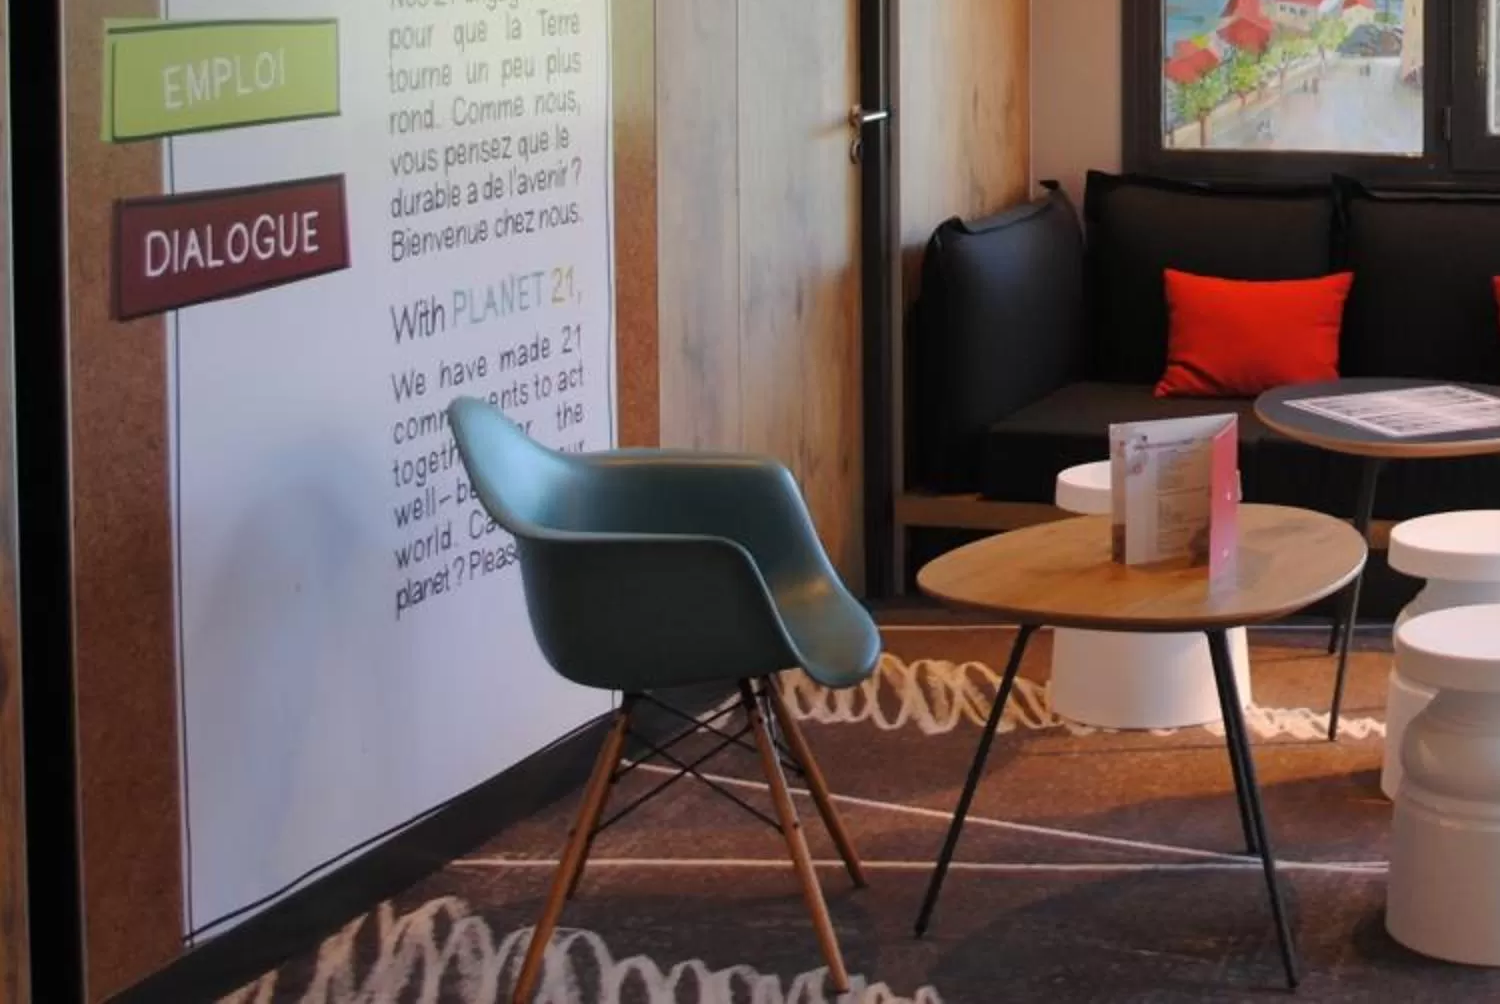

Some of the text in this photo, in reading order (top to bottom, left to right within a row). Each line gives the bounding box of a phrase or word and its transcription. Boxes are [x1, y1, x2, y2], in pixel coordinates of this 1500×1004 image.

[388, 8, 580, 58] pour que la Terre
[161, 48, 285, 111] EMPLOI
[388, 47, 582, 94] tourne un peu plus
[452, 96, 525, 126] Comme
[390, 123, 569, 177] vous pensez que le
[390, 182, 461, 218] durable
[467, 182, 478, 205] a
[482, 172, 504, 200] de
[144, 212, 319, 277] DIALOGUE
[390, 219, 489, 262] Bienvenue
[494, 207, 535, 238] chez
[389, 294, 446, 345] With
[452, 270, 547, 328] PLANET
[391, 322, 582, 404] We have made 21
[534, 373, 552, 399] to
[557, 359, 584, 393] act
[392, 437, 463, 488] togeth
[556, 400, 584, 432] the
[468, 545, 520, 581] Pleas
